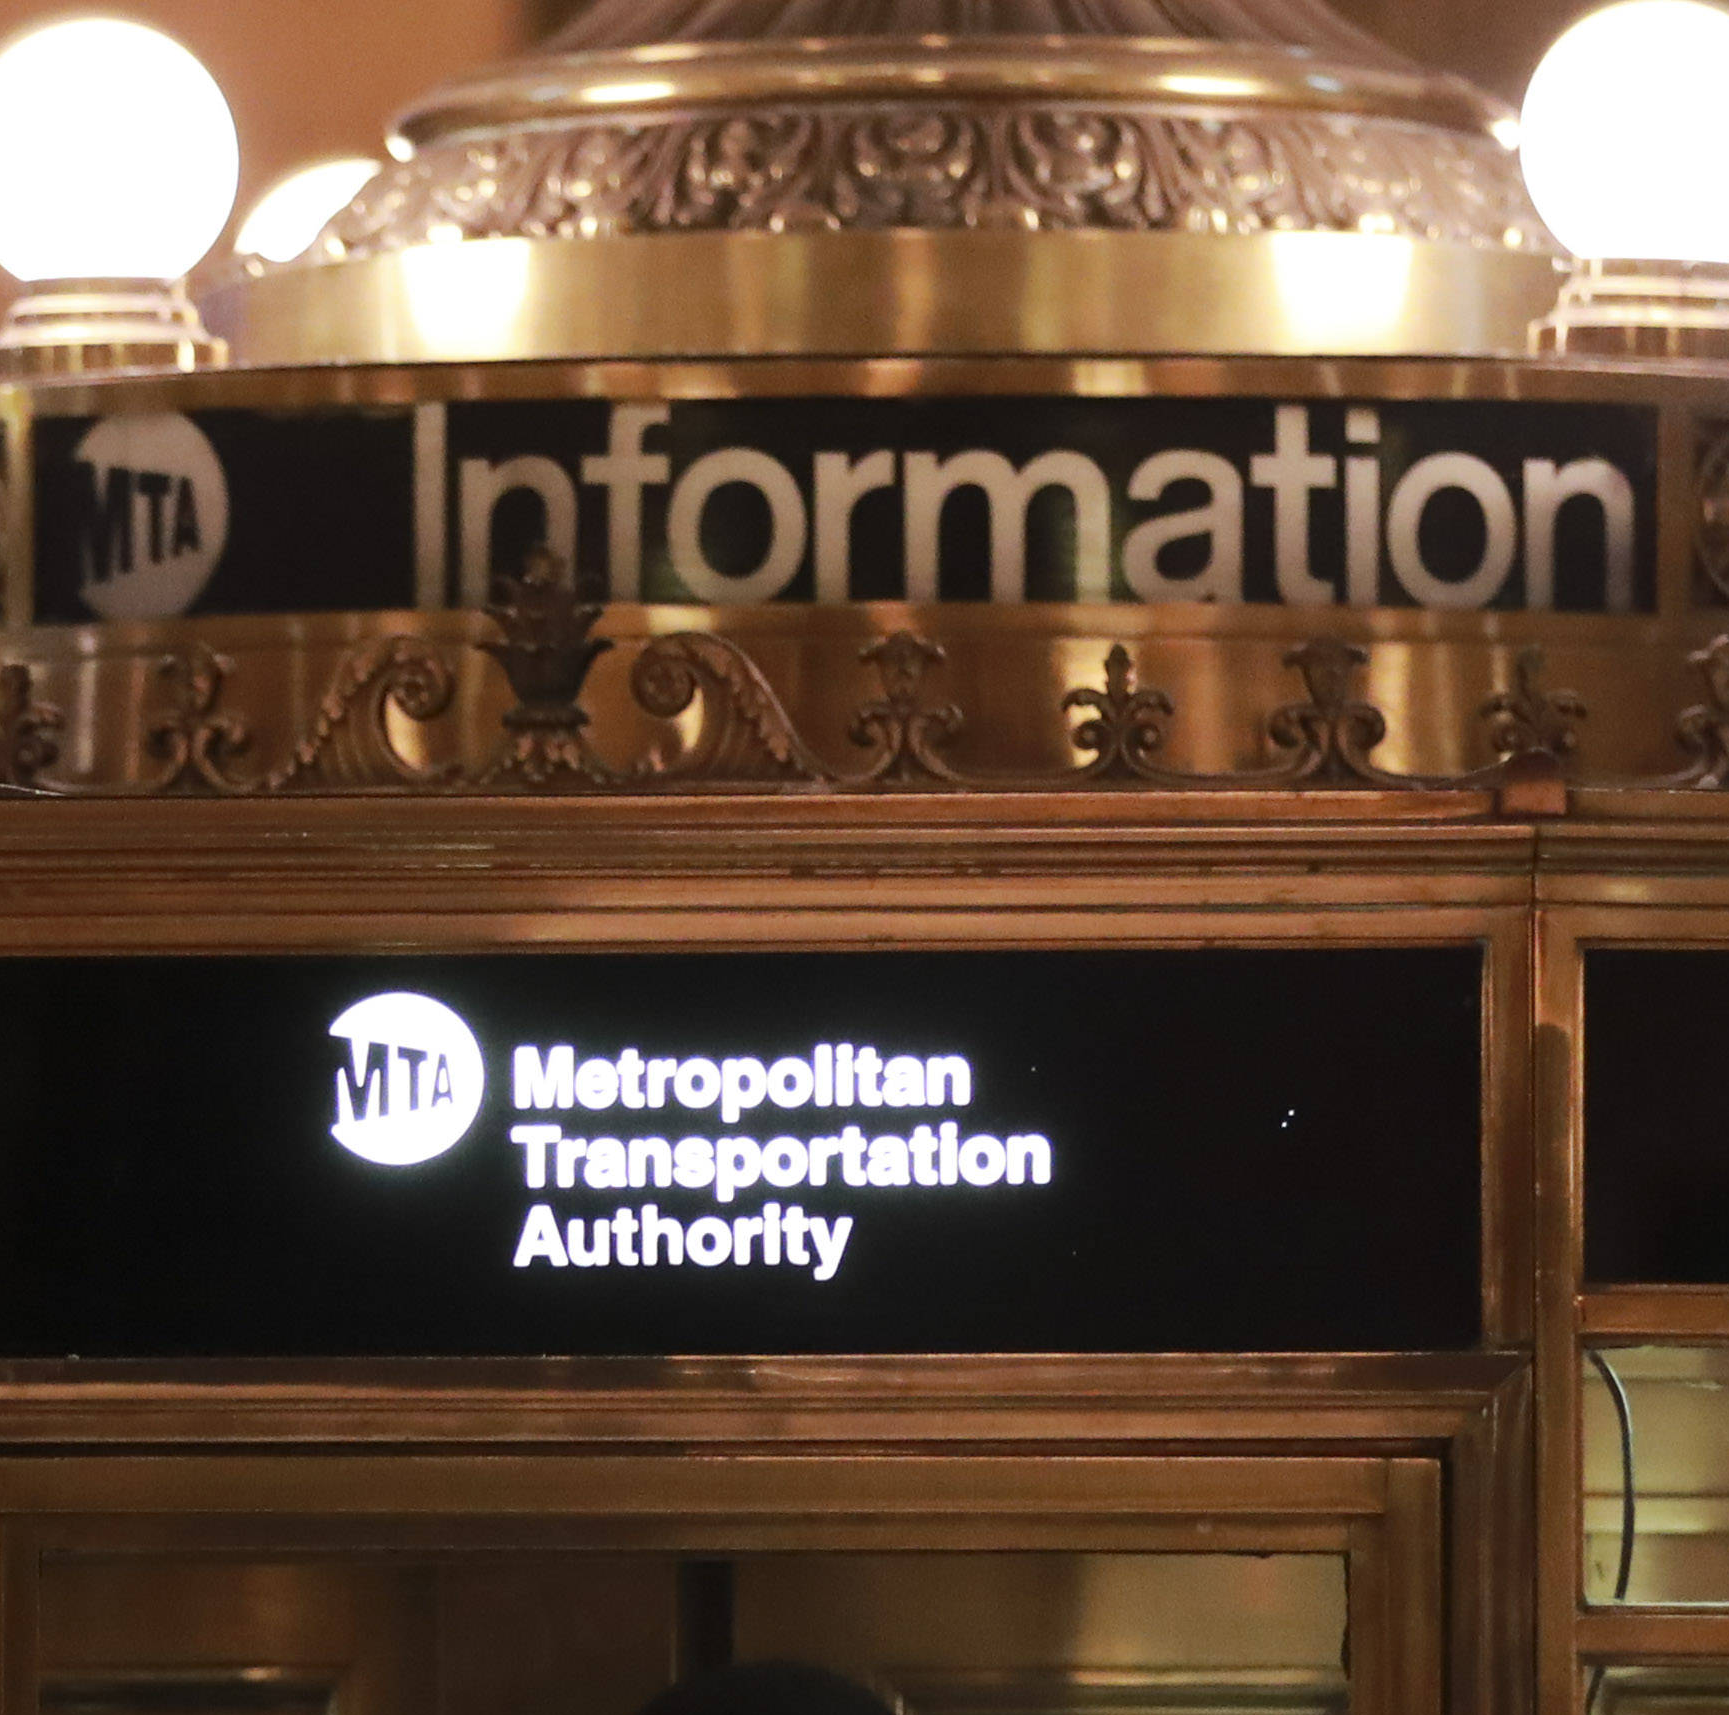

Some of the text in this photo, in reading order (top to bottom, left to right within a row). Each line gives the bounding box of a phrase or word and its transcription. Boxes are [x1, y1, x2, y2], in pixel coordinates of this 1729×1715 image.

[414, 401, 1637, 612] Information
[512, 1043, 973, 1123] Metropolitan
[510, 1121, 1053, 1203] Transportation
[512, 1202, 855, 1281] Authority
